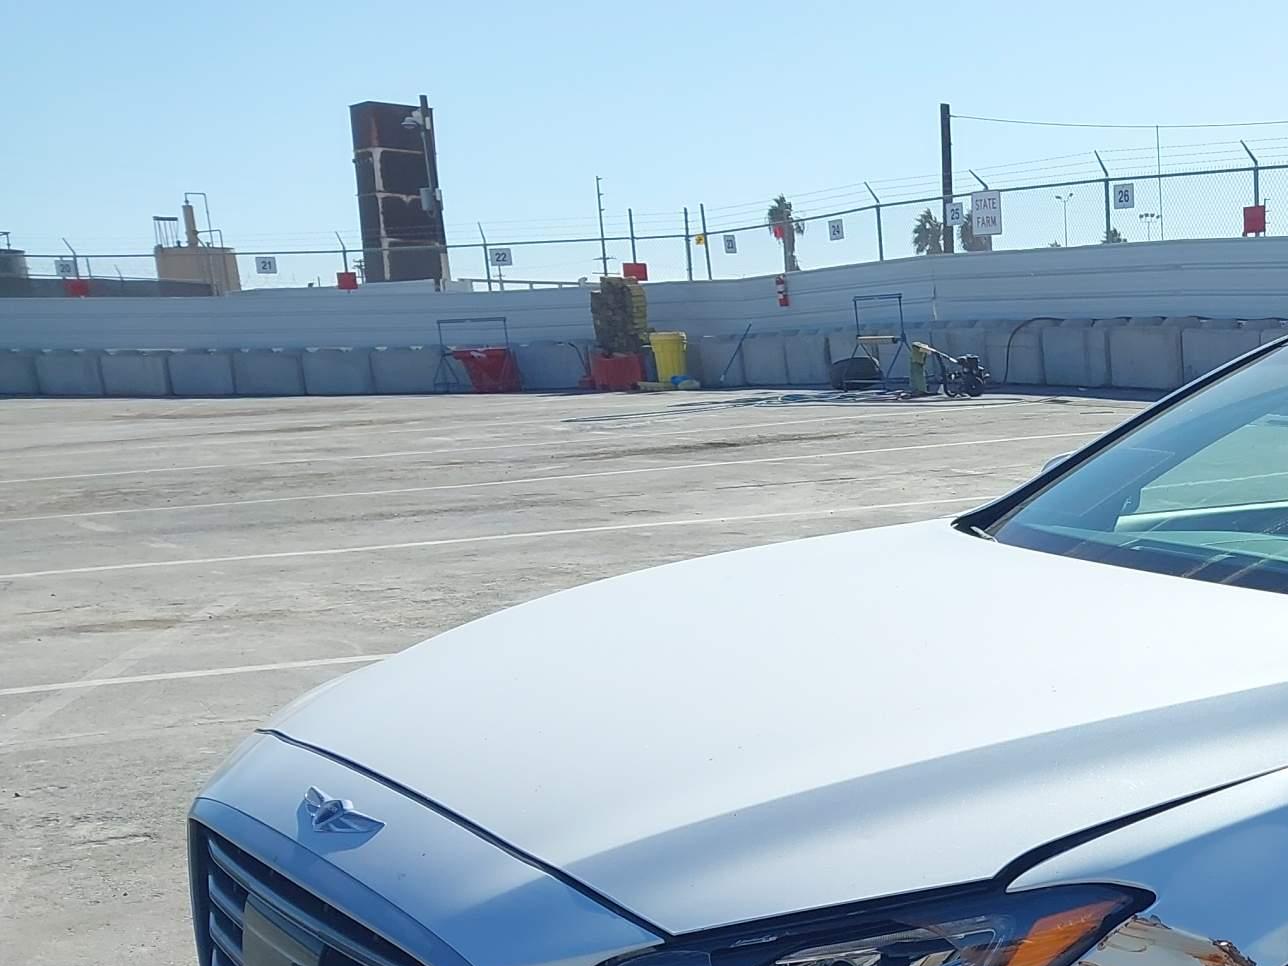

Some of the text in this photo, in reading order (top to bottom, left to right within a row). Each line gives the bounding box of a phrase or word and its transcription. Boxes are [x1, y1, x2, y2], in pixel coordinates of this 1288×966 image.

[1118, 189, 1130, 203] 26
[975, 197, 997, 211] STATE
[950, 208, 960, 220] 25
[976, 215, 997, 228] FARM
[494, 252, 508, 262] 22
[261, 260, 273, 270] 21
